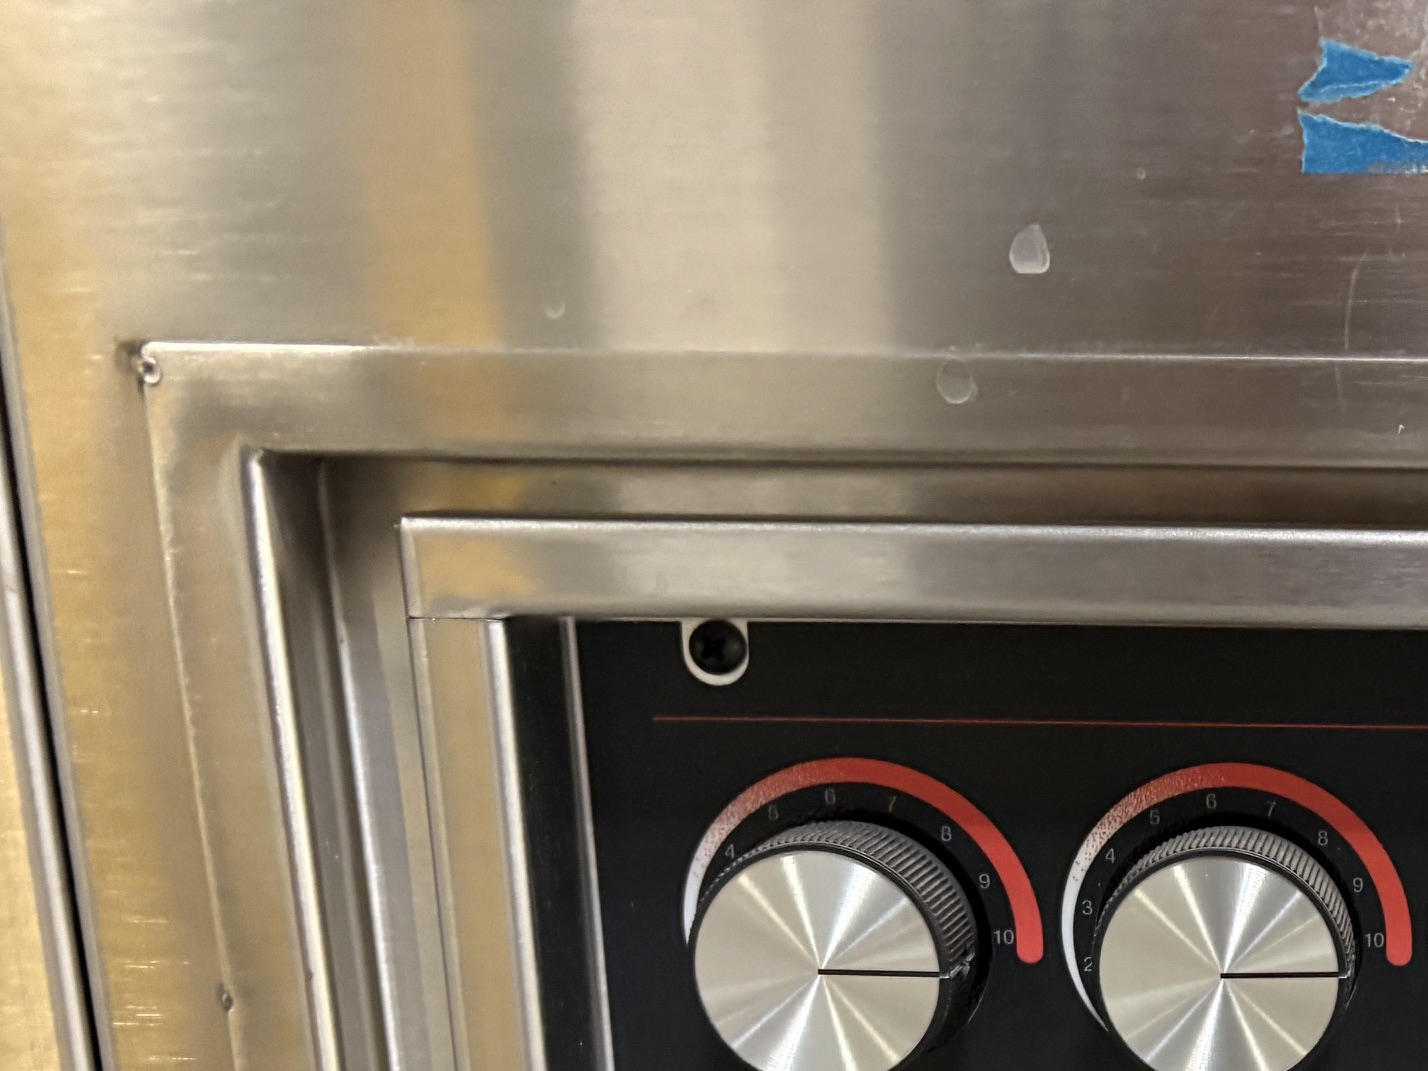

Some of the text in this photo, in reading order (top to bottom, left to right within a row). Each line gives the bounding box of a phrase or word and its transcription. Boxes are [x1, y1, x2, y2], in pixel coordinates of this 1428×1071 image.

[724, 844, 735, 859] 4
[889, 796, 896, 812] 7
[941, 826, 951, 841] 8
[979, 874, 990, 888] 9
[993, 929, 1015, 945] 10
[1082, 794, 1385, 971] 2 3 4 5 6 7 8 9 10
